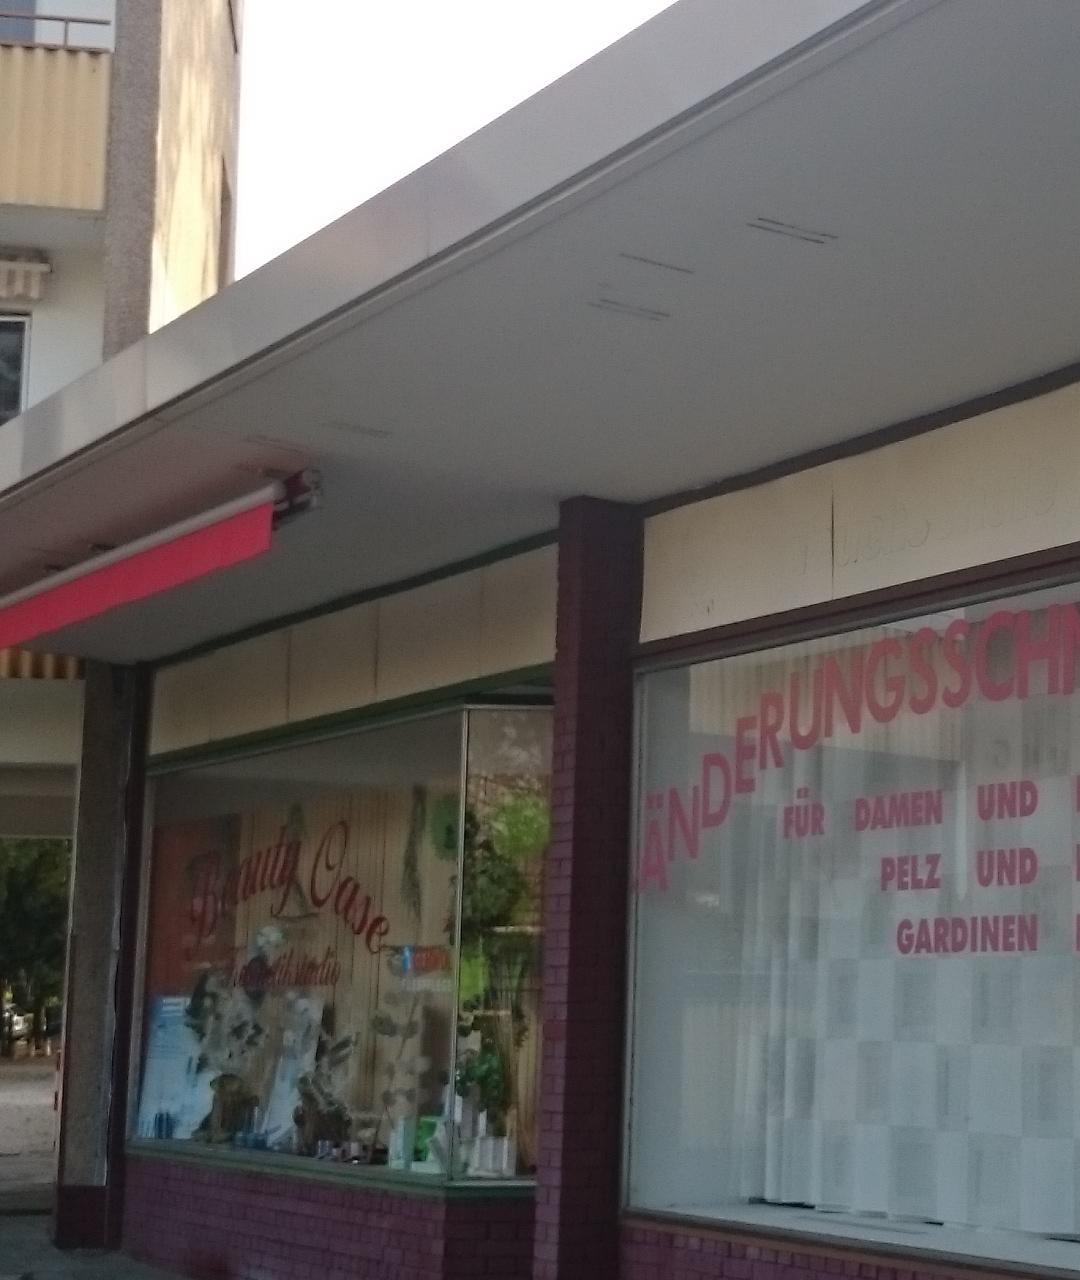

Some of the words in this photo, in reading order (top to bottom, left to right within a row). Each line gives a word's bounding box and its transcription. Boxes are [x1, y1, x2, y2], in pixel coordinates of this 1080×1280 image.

[783, 786, 825, 839] FÜR
[854, 790, 943, 832] DAMEN
[977, 779, 1039, 821] UND
[310, 820, 392, 955] Case
[880, 855, 942, 891] PELZ
[977, 847, 1039, 887] UND
[896, 913, 1039, 954] GARDINEN
